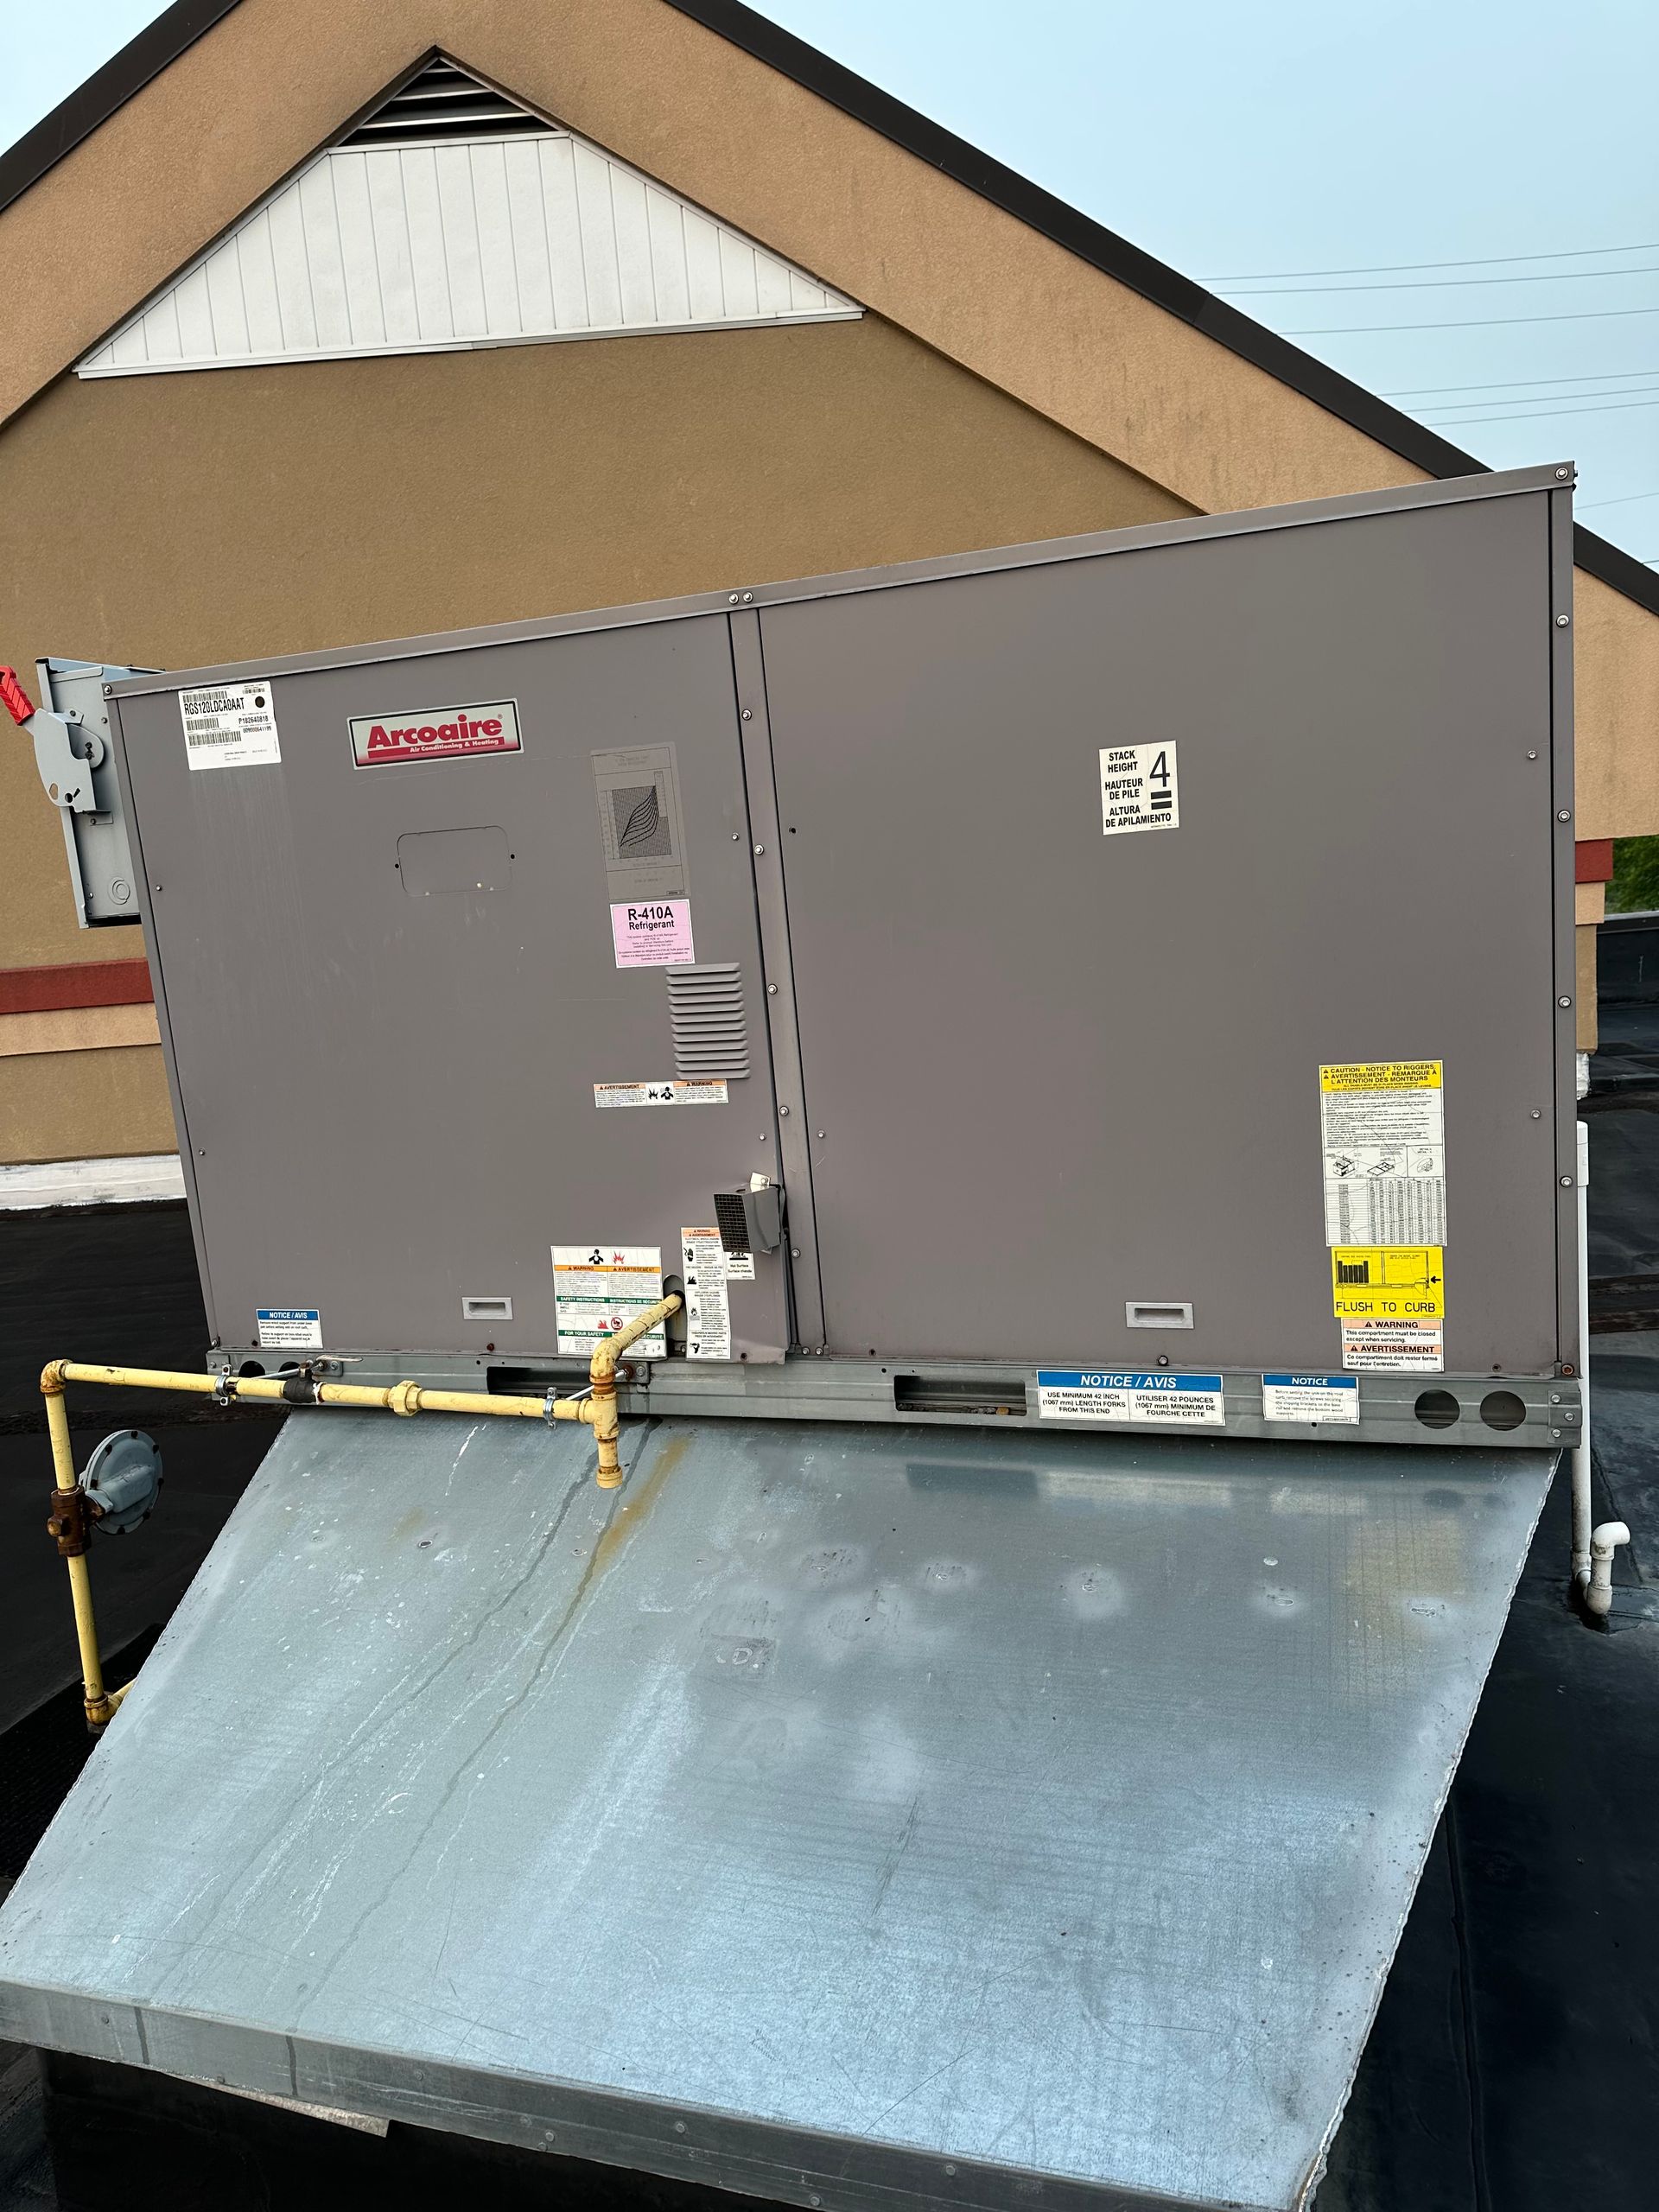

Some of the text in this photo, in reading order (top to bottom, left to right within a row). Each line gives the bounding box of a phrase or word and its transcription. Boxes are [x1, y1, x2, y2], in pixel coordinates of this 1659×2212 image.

[367, 715, 502, 748] Arcoaire
[422, 742, 462, 752] Conditioning
[1109, 750, 1135, 761] STACK
[1108, 761, 1138, 772] HEIGHT
[1150, 751, 1170, 787] 4
[1105, 778, 1143, 790] HAUTEUR
[1109, 789, 1140, 800] DE PILE
[1109, 805, 1141, 816] ALTURA
[1118, 813, 1171, 826] APILAMIENTO
[628, 906, 673, 920] R-410A
[629, 920, 675, 931] Refrigerant
[1336, 1302, 1435, 1312] FLUSH TO CURB
[1081, 1376, 1177, 1388] NOTICE / AVIS
